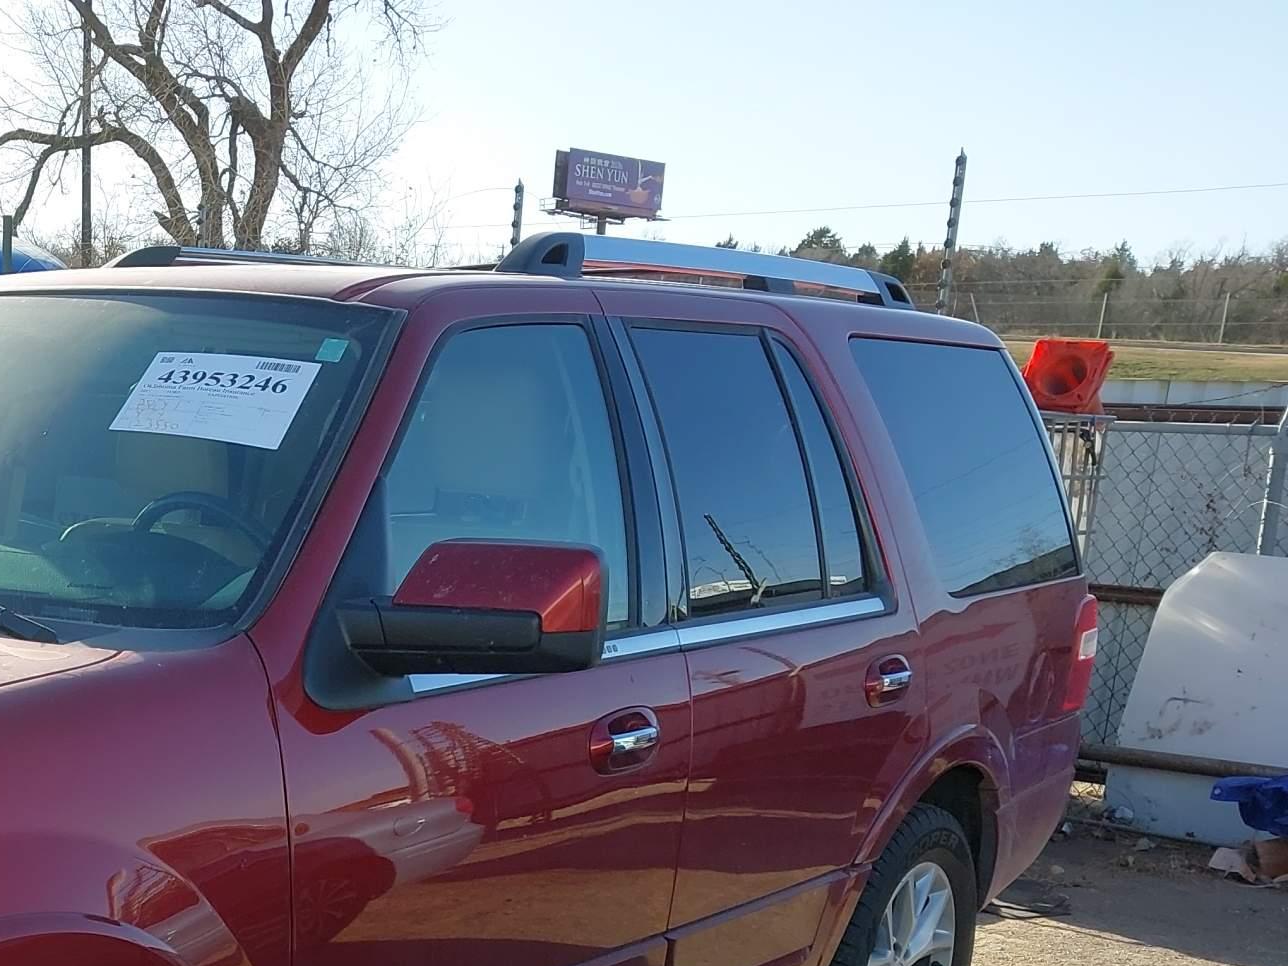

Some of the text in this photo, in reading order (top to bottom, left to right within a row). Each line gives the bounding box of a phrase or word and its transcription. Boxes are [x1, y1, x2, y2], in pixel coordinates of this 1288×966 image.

[574, 163, 604, 180] SHEN
[606, 167, 629, 185] YUN
[157, 368, 292, 395] 43953246
